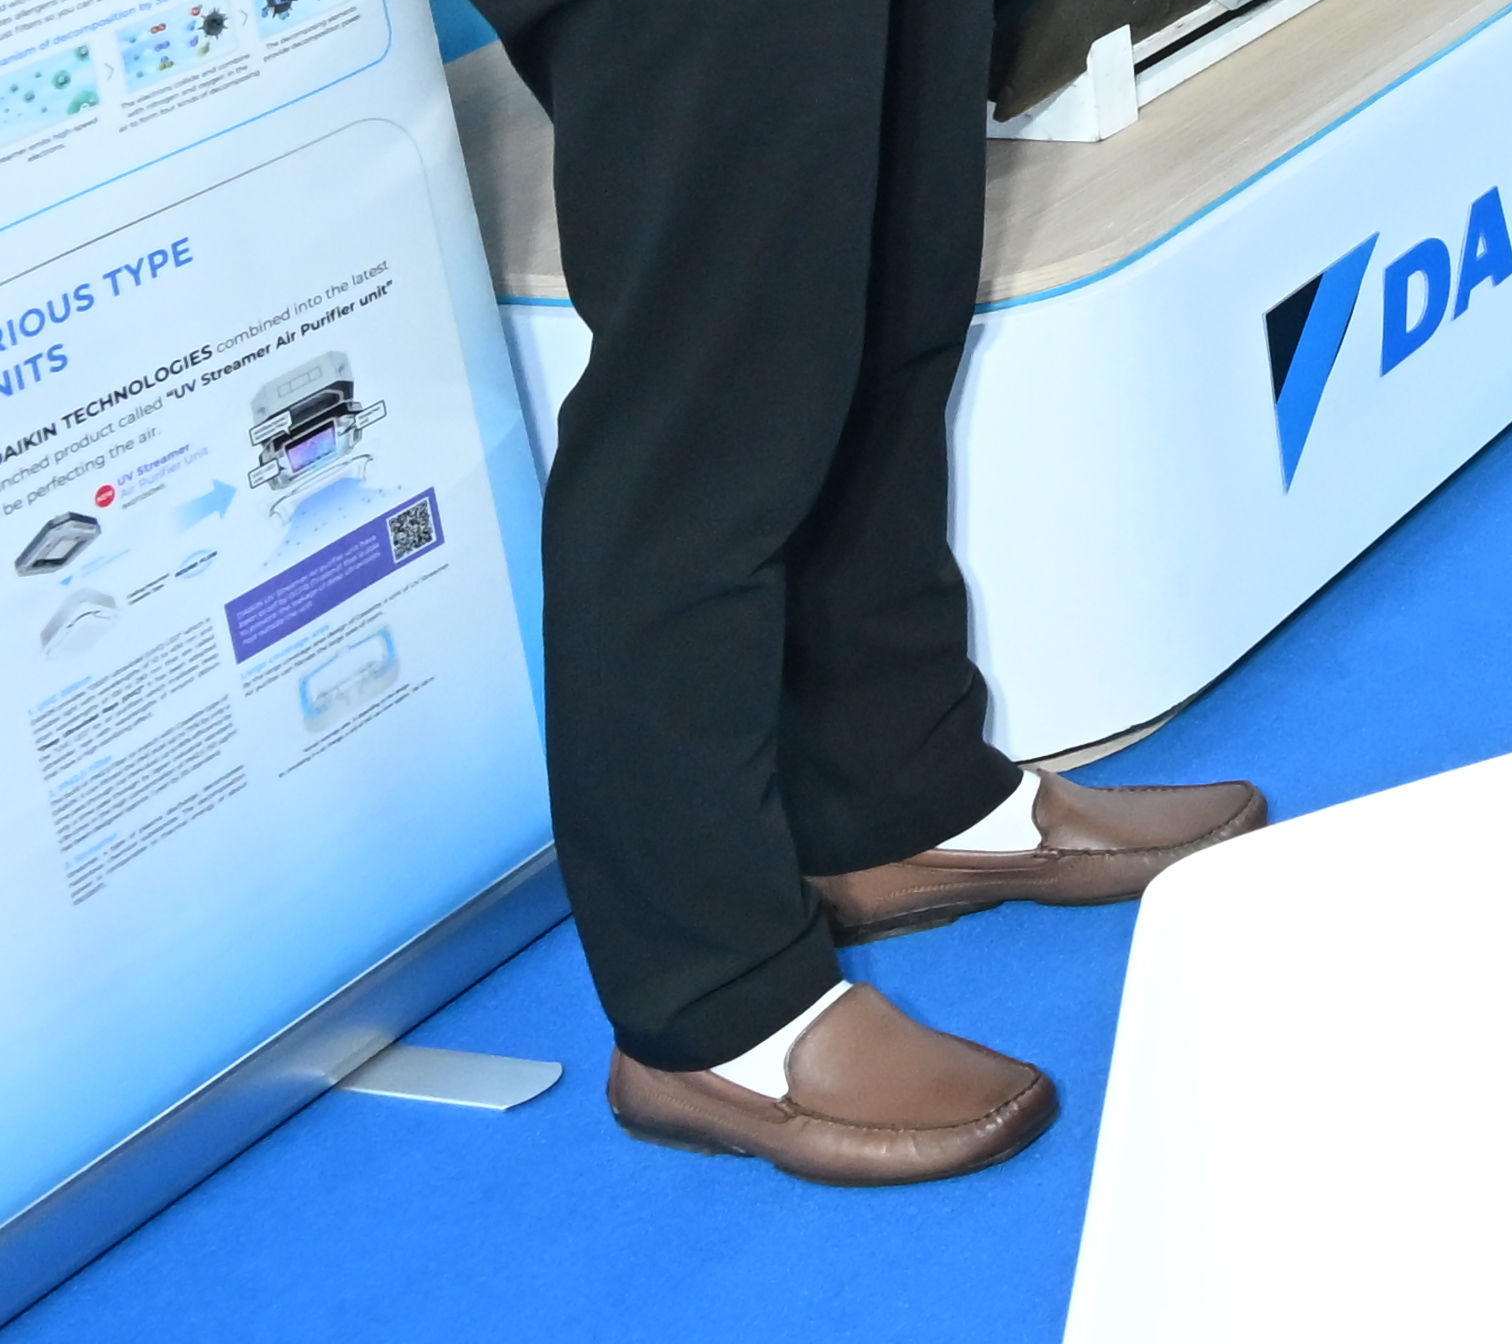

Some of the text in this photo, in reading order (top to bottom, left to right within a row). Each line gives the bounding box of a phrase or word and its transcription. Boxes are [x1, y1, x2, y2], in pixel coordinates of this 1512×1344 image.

[102, 235, 195, 298] TYPE
[0, 257, 391, 464] AIKIN TECHNOLOGIES combined into the latest
[53, 422, 116, 466] product
[118, 395, 165, 429] called
[199, 340, 273, 389] Streamer
[274, 329, 298, 351] Air
[299, 298, 356, 339] Purifier
[3, 497, 24, 516] be
[25, 453, 107, 506] perfecting
[107, 438, 136, 461] the
[116, 442, 191, 488] UV Streamer
[183, 446, 210, 466] Unit
